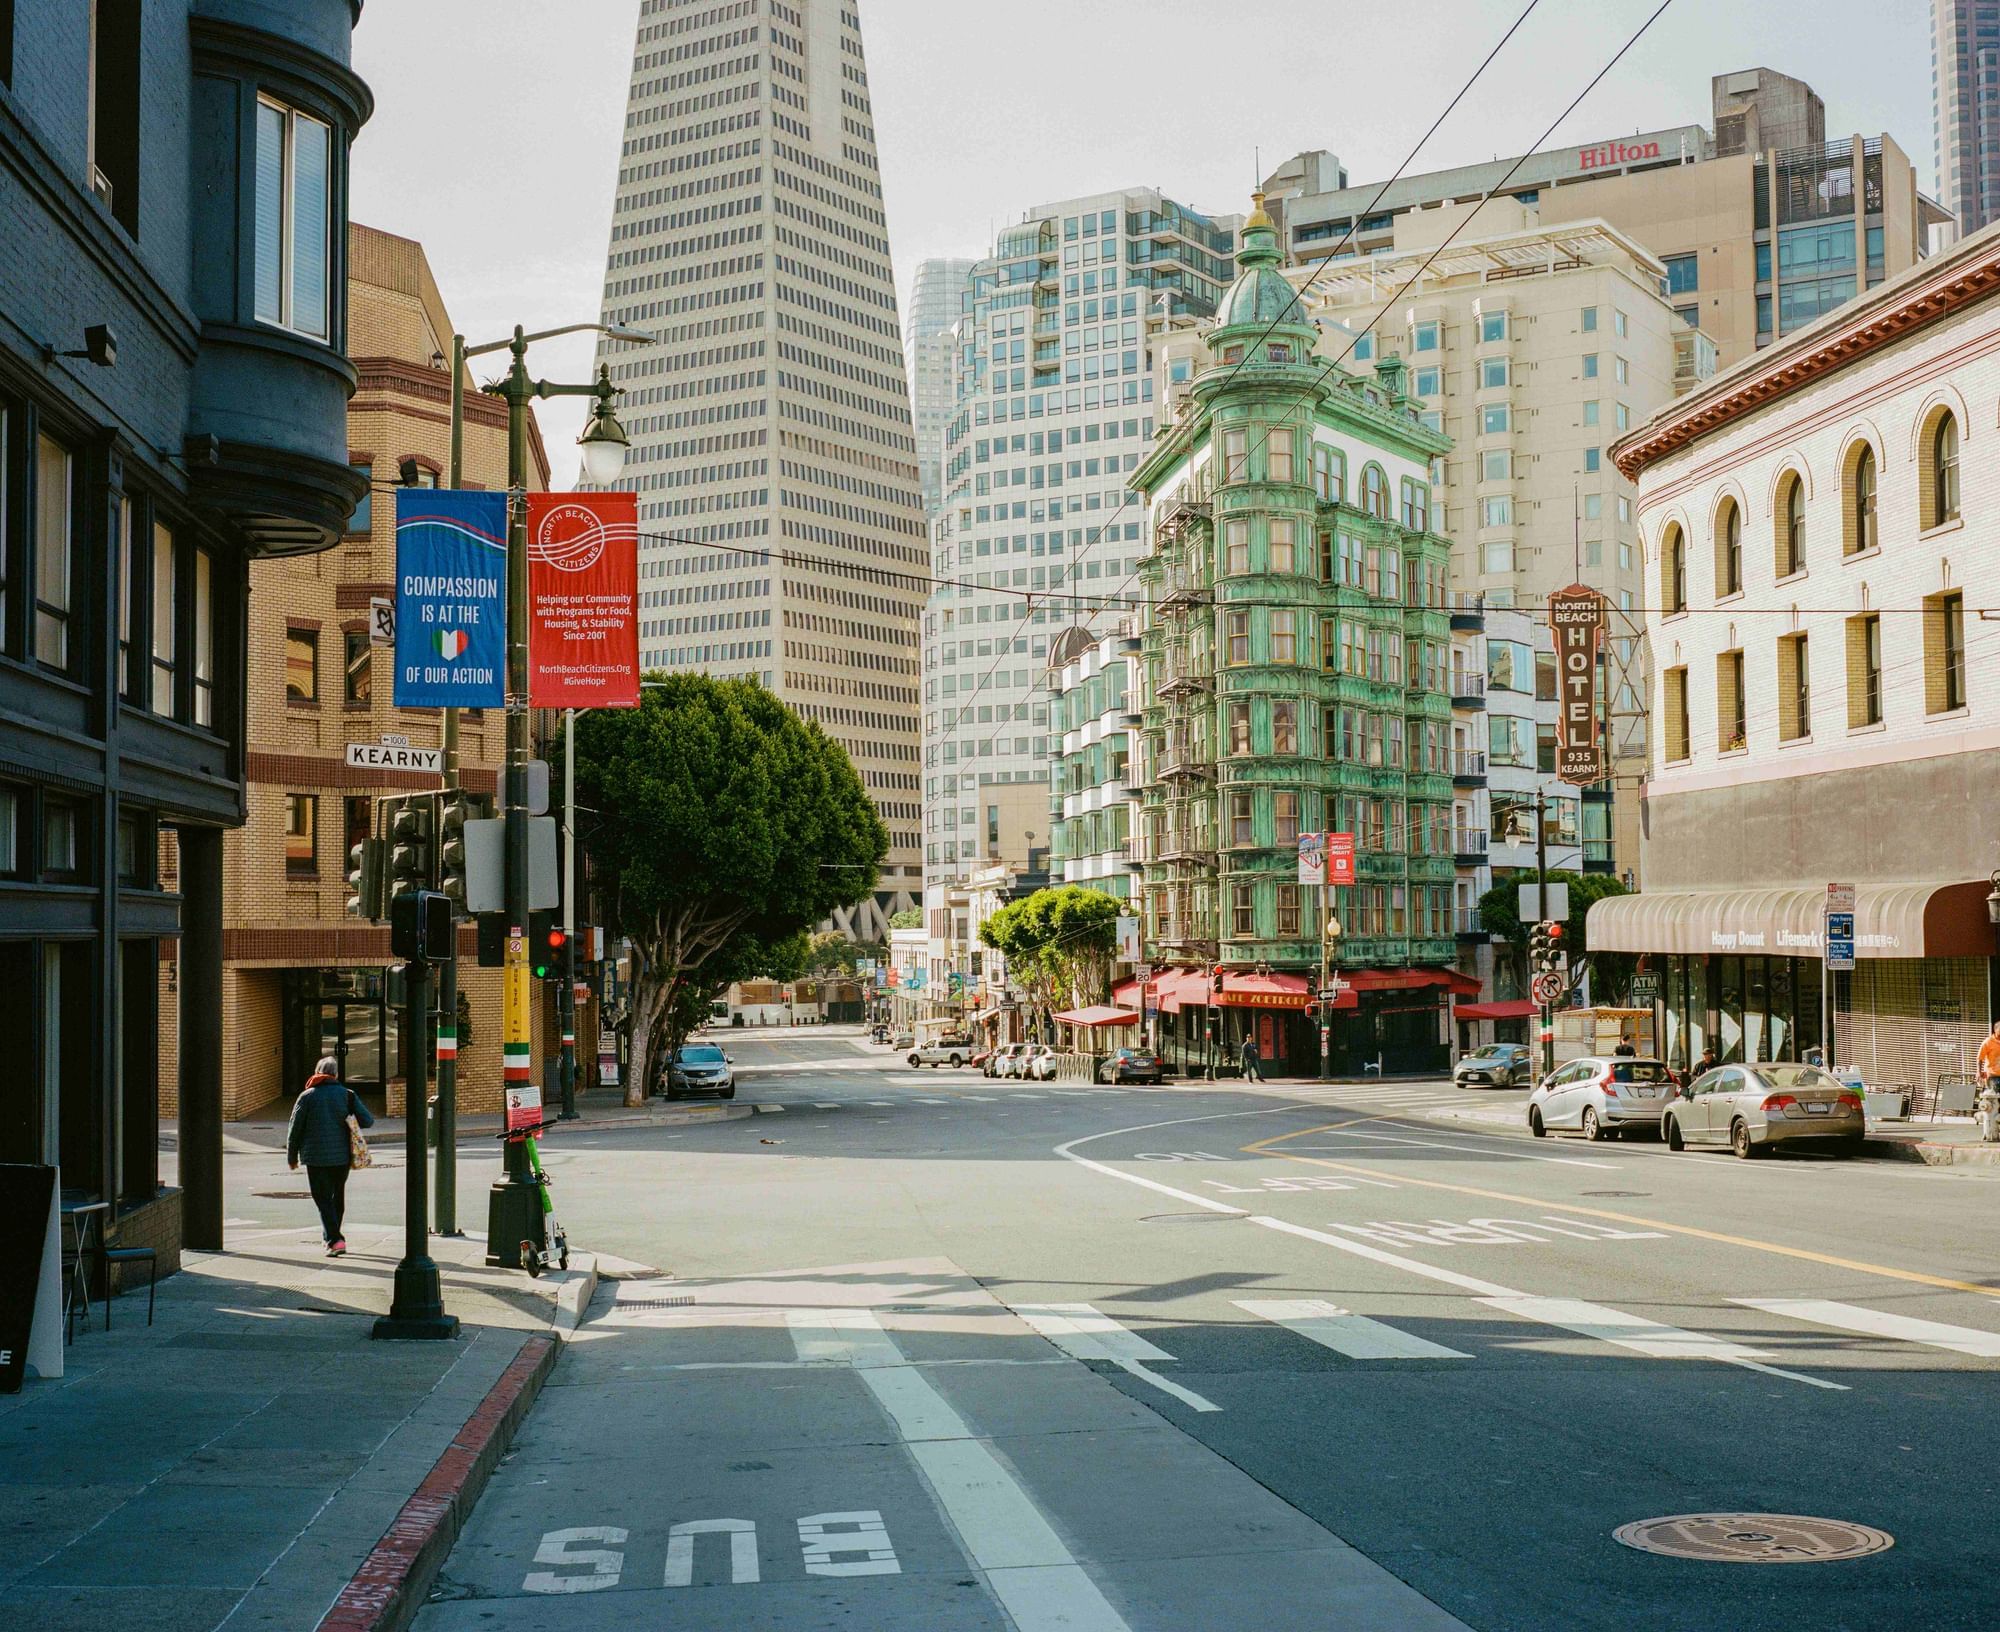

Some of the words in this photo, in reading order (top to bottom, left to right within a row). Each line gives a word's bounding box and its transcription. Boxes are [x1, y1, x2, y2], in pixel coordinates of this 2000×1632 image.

[1579, 140, 1660, 170] Hilton
[543, 510, 563, 543] NORTH
[564, 509, 596, 529] BEACH
[558, 545, 600, 568] CITIZENS
[404, 576, 497, 599] COMPASSION
[536, 594, 568, 606] Helping
[569, 596, 584, 605] our
[585, 594, 632, 606] Community
[1555, 602, 1597, 612] NORTH
[421, 605, 434, 623] IS
[438, 605, 455, 623] AT
[457, 605, 480, 624] THE
[536, 606, 555, 617] with
[556, 606, 594, 619] Programs
[595, 606, 608, 616] for
[609, 606, 632, 618] Food,
[1555, 612, 1597, 623] BEACH
[544, 618, 580, 631] Housing,
[581, 619, 589, 628] &
[589, 618, 624, 631] Stability
[563, 630, 585, 641] Since
[586, 631, 606, 640] 2001
[405, 667, 421, 683] OF
[424, 667, 448, 684] OUR
[451, 668, 493, 684] ACTION
[539, 664, 631, 676] NorthBeachCitizens.Org
[563, 676, 606, 686] #GiveHope
[1567, 627, 1590, 747] HOTEL
[390, 736, 407, 745] 1000
[353, 748, 437, 768] KEARNY
[1567, 752, 1591, 762] 935
[1561, 764, 1597, 773] KEARNY
[1711, 931, 1737, 949] Happy
[1739, 931, 1765, 947] Donut
[1776, 929, 1818, 947] Lifemark
[604, 960, 614, 1004] PARK
[1137, 974, 1150, 982] 20
[1633, 977, 1657, 988] ATM
[1134, 1151, 1231, 1161] NO
[1202, 1175, 1400, 1193] LEFT
[1327, 1216, 1670, 1248] TURN
[523, 1510, 902, 1593] BUS
